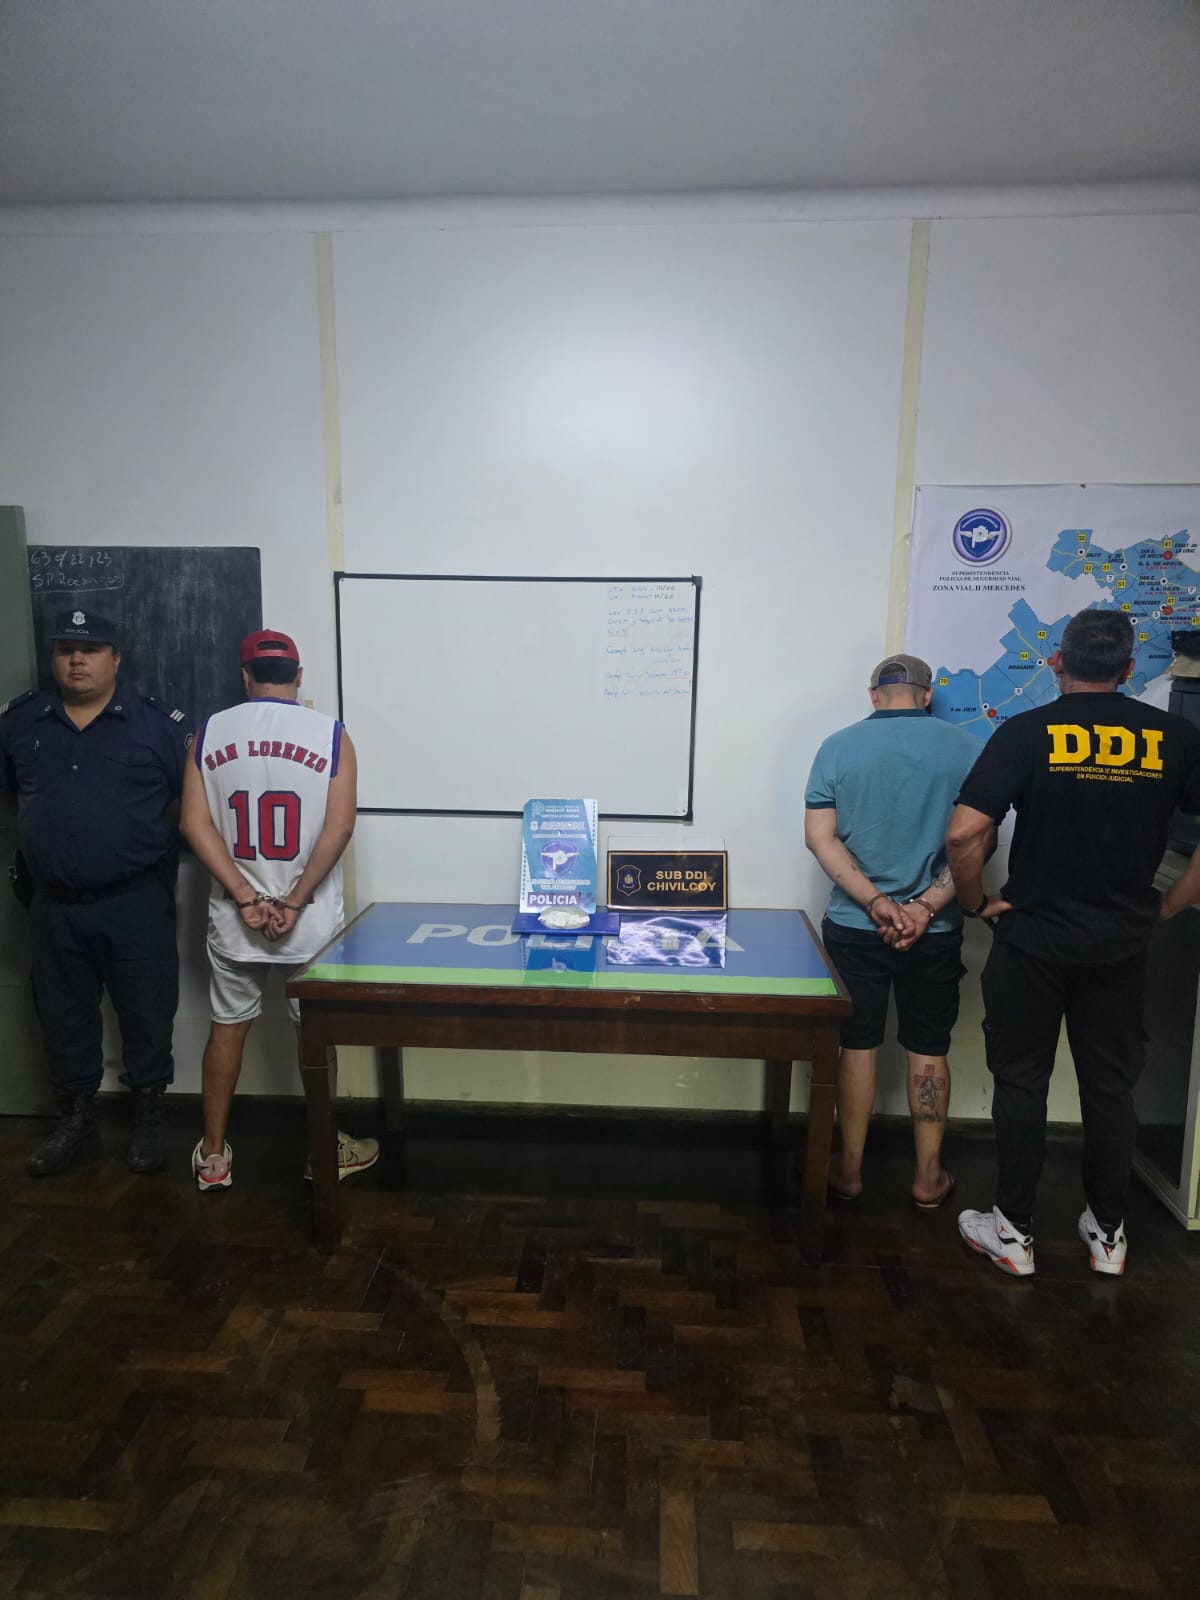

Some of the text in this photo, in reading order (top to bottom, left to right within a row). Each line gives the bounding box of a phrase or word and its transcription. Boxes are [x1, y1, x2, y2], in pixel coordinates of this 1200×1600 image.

[1046, 723, 1164, 771] DDI
[204, 740, 328, 774] SAN LORENZO
[1109, 775, 1134, 783] JUDICIAL
[1111, 768, 1163, 779] INVESTIGACIONES
[227, 789, 302, 862] 10
[655, 870, 708, 880] SUB DDI
[646, 881, 717, 892] CHIVILCOY
[529, 894, 578, 905] POLICIA
